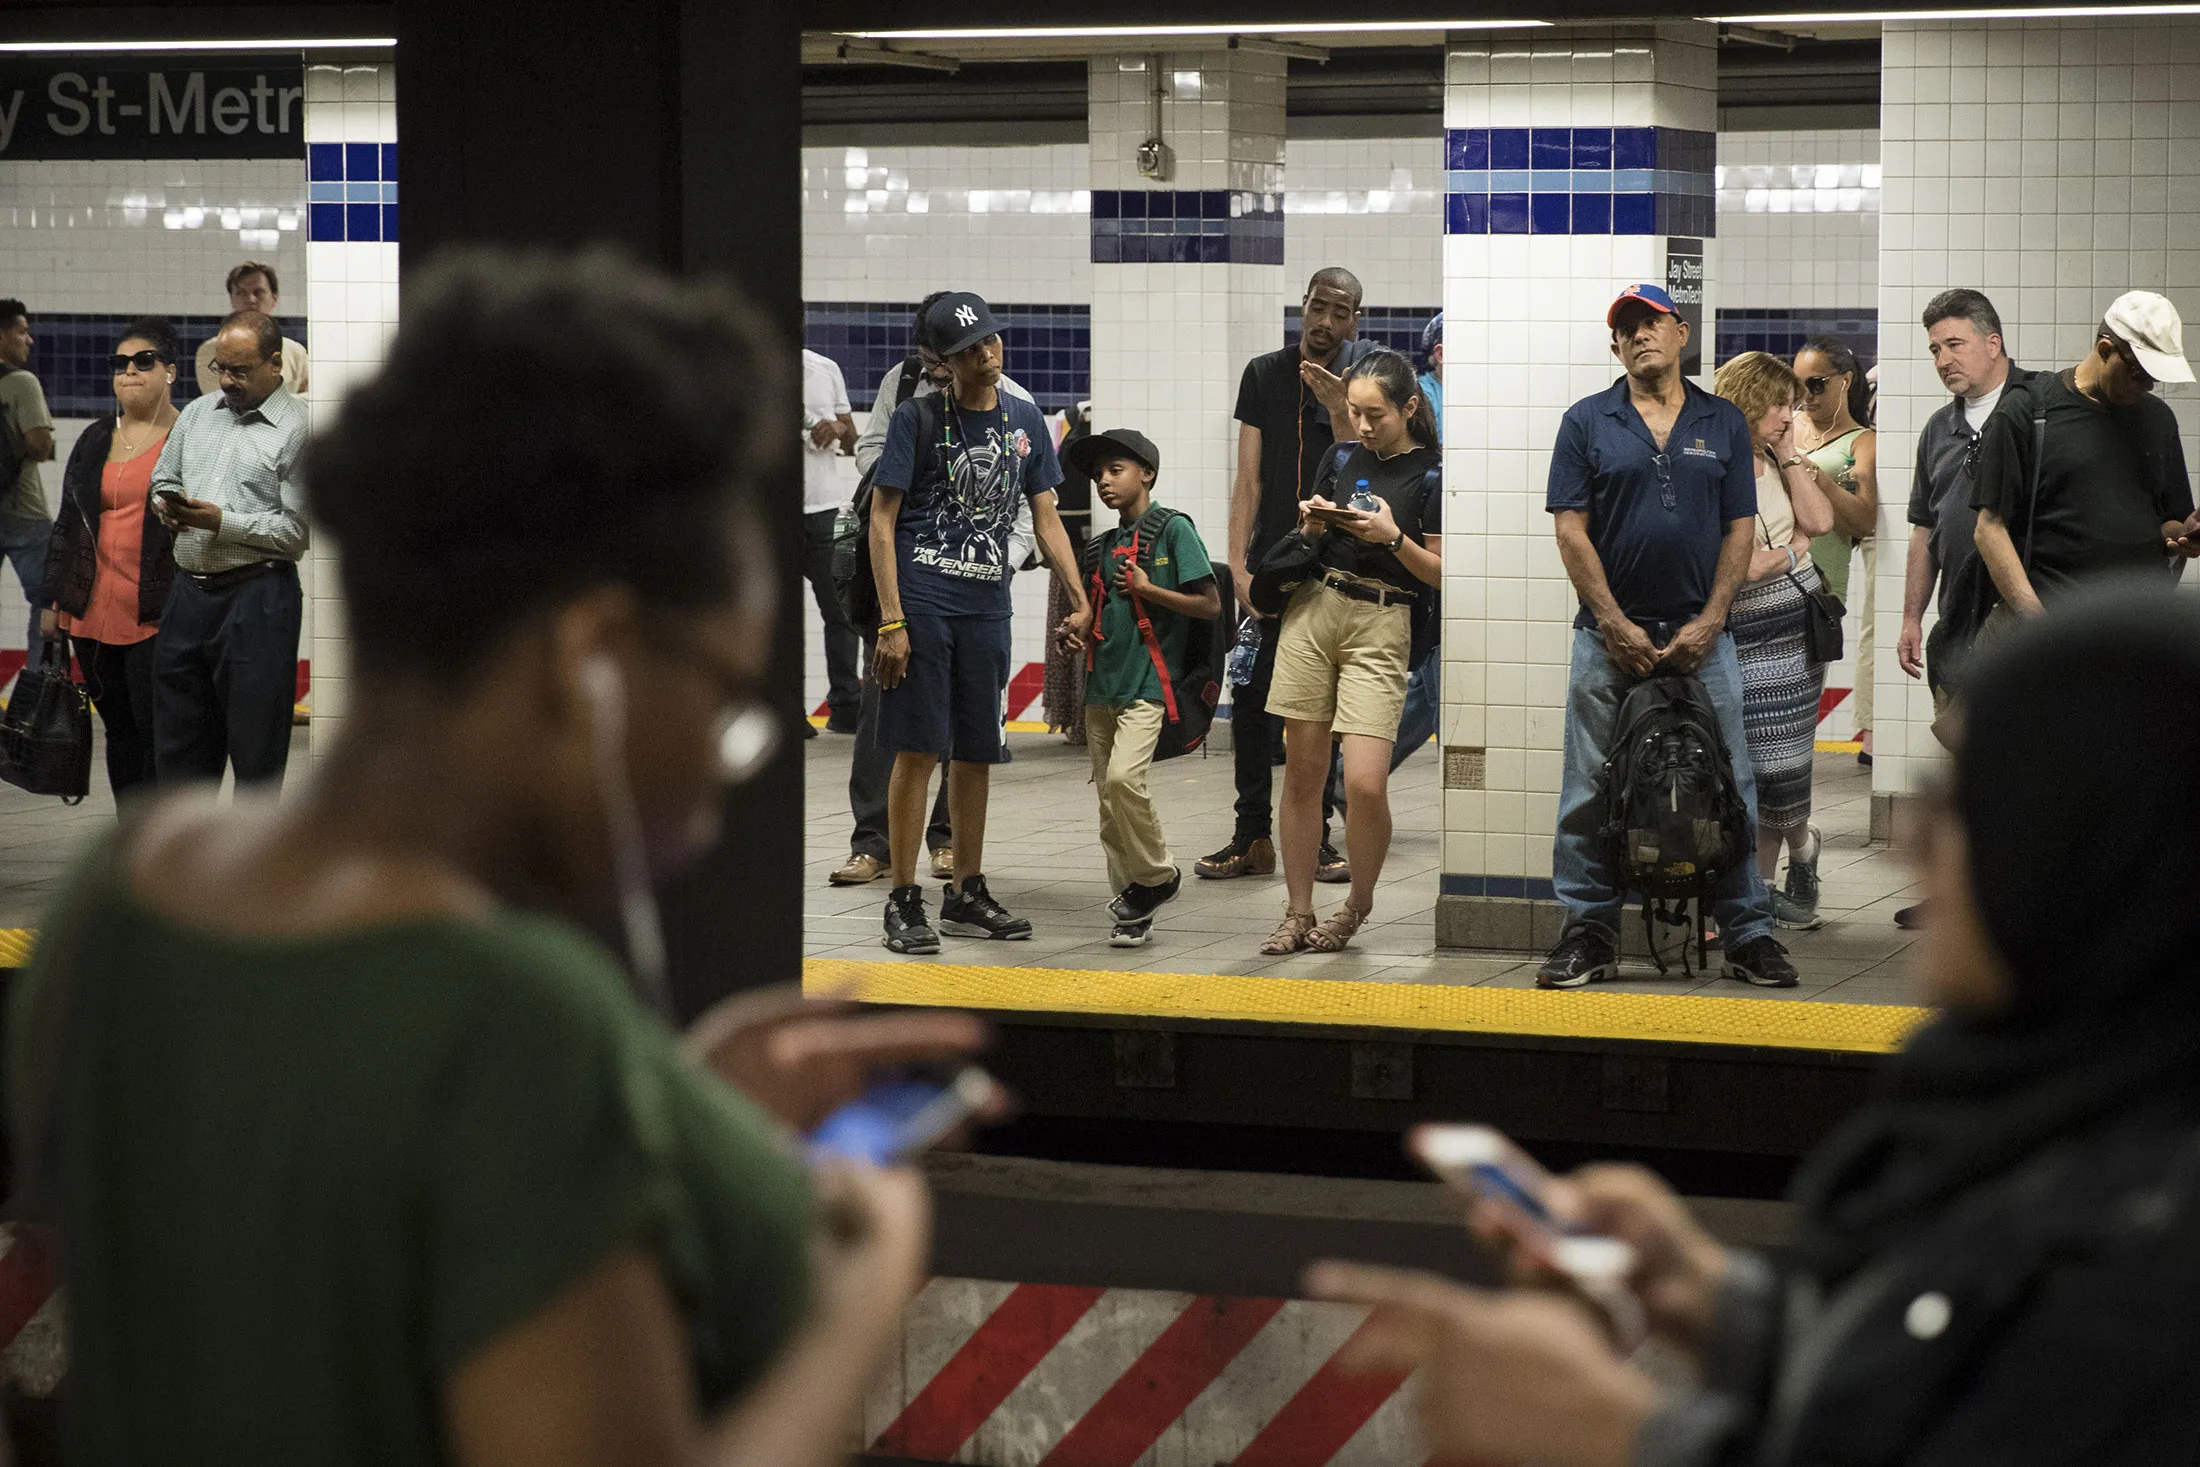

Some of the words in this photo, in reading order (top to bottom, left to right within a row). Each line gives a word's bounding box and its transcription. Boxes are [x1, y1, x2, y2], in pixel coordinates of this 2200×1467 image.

[47, 72, 303, 136] St-Metr
[1668, 259, 1682, 283] Jay
[1682, 259, 1702, 279] Street
[1668, 285, 1702, 304] MetroTech
[955, 304, 979, 327] NY
[913, 547, 938, 556] THE
[912, 554, 1003, 575] AVENGERS
[941, 568, 962, 577] AGE
